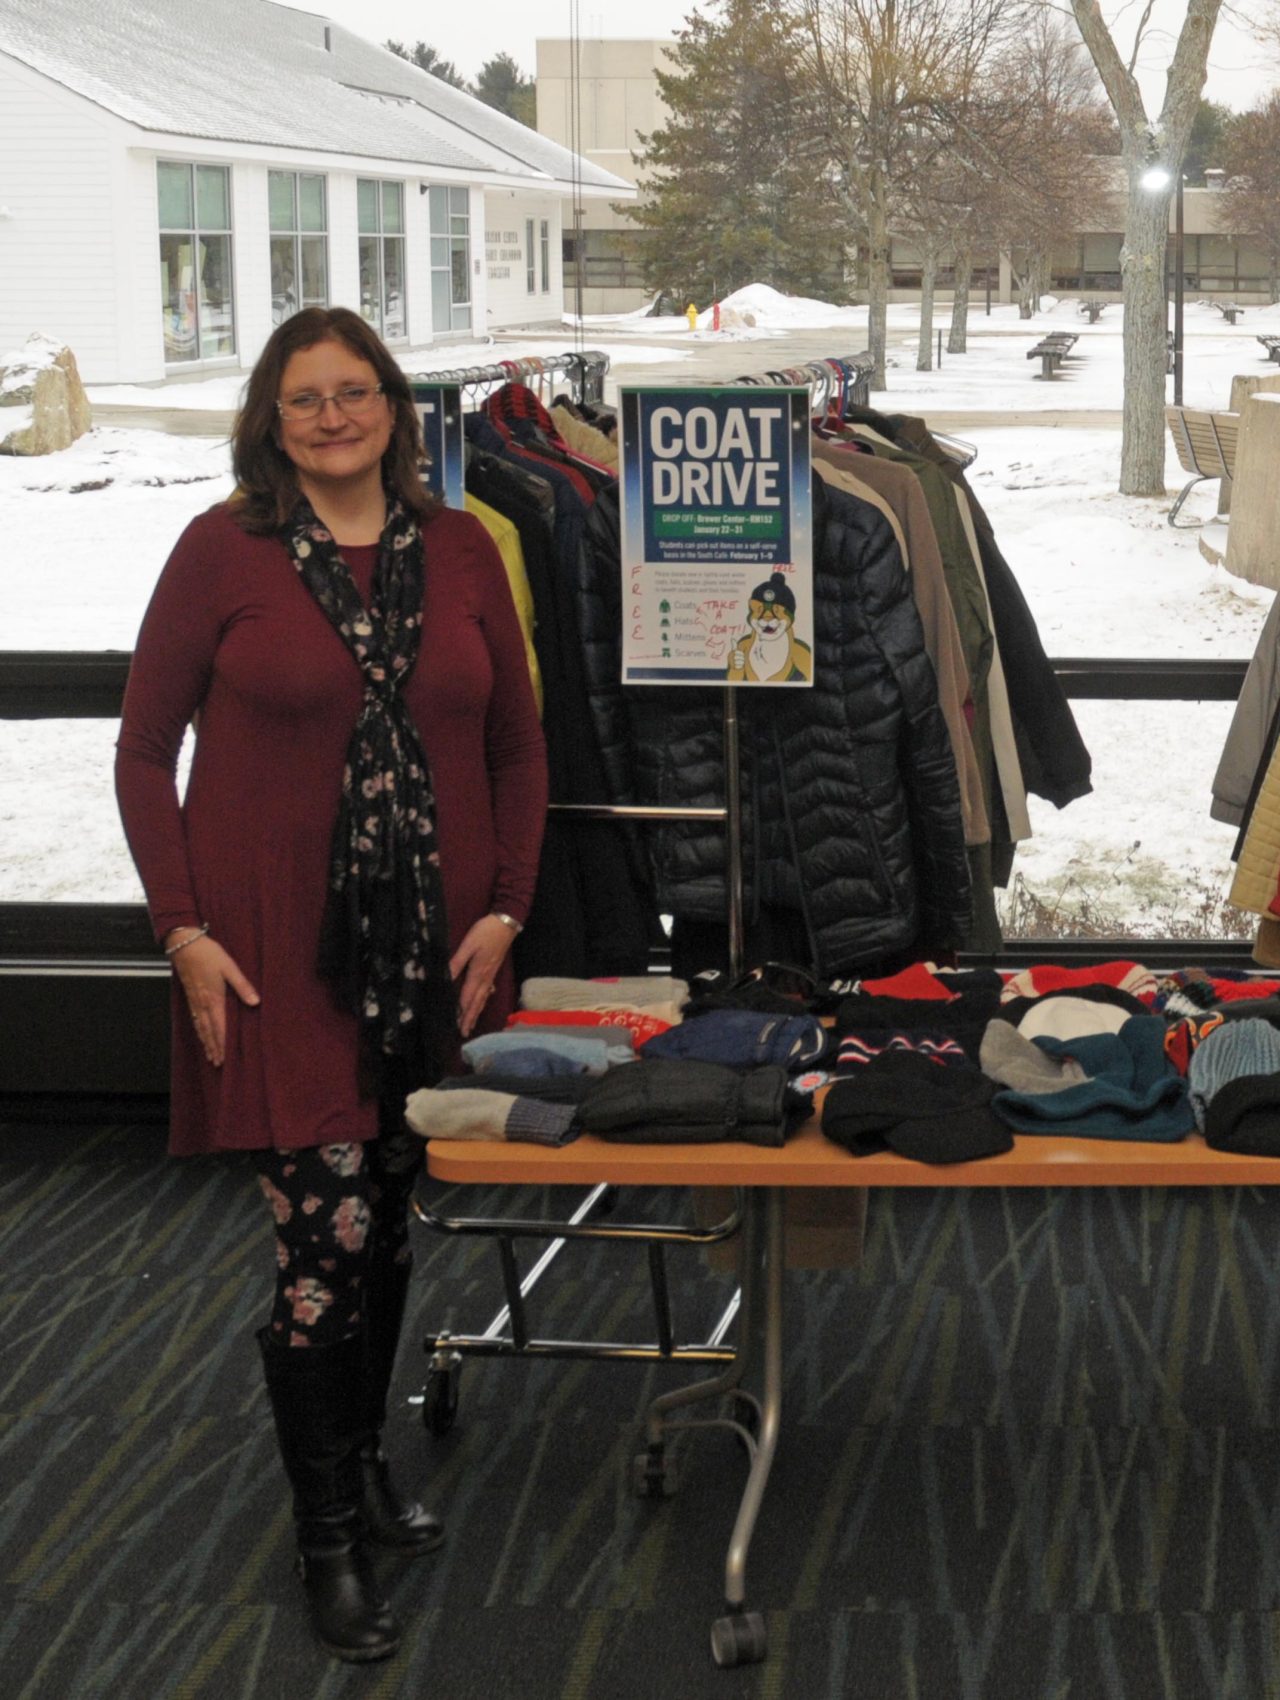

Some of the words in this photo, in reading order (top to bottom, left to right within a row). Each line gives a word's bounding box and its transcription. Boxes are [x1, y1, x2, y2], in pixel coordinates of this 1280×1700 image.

[650, 406, 782, 459] COAT
[652, 461, 781, 506] DRIVE
[694, 526, 720, 535] January
[674, 600, 697, 610] Coats
[704, 600, 738, 610] TAKE
[715, 610, 722, 619] A
[674, 617, 693, 626] Hats
[674, 633, 706, 642] Mittens
[675, 649, 706, 658] Scarves
